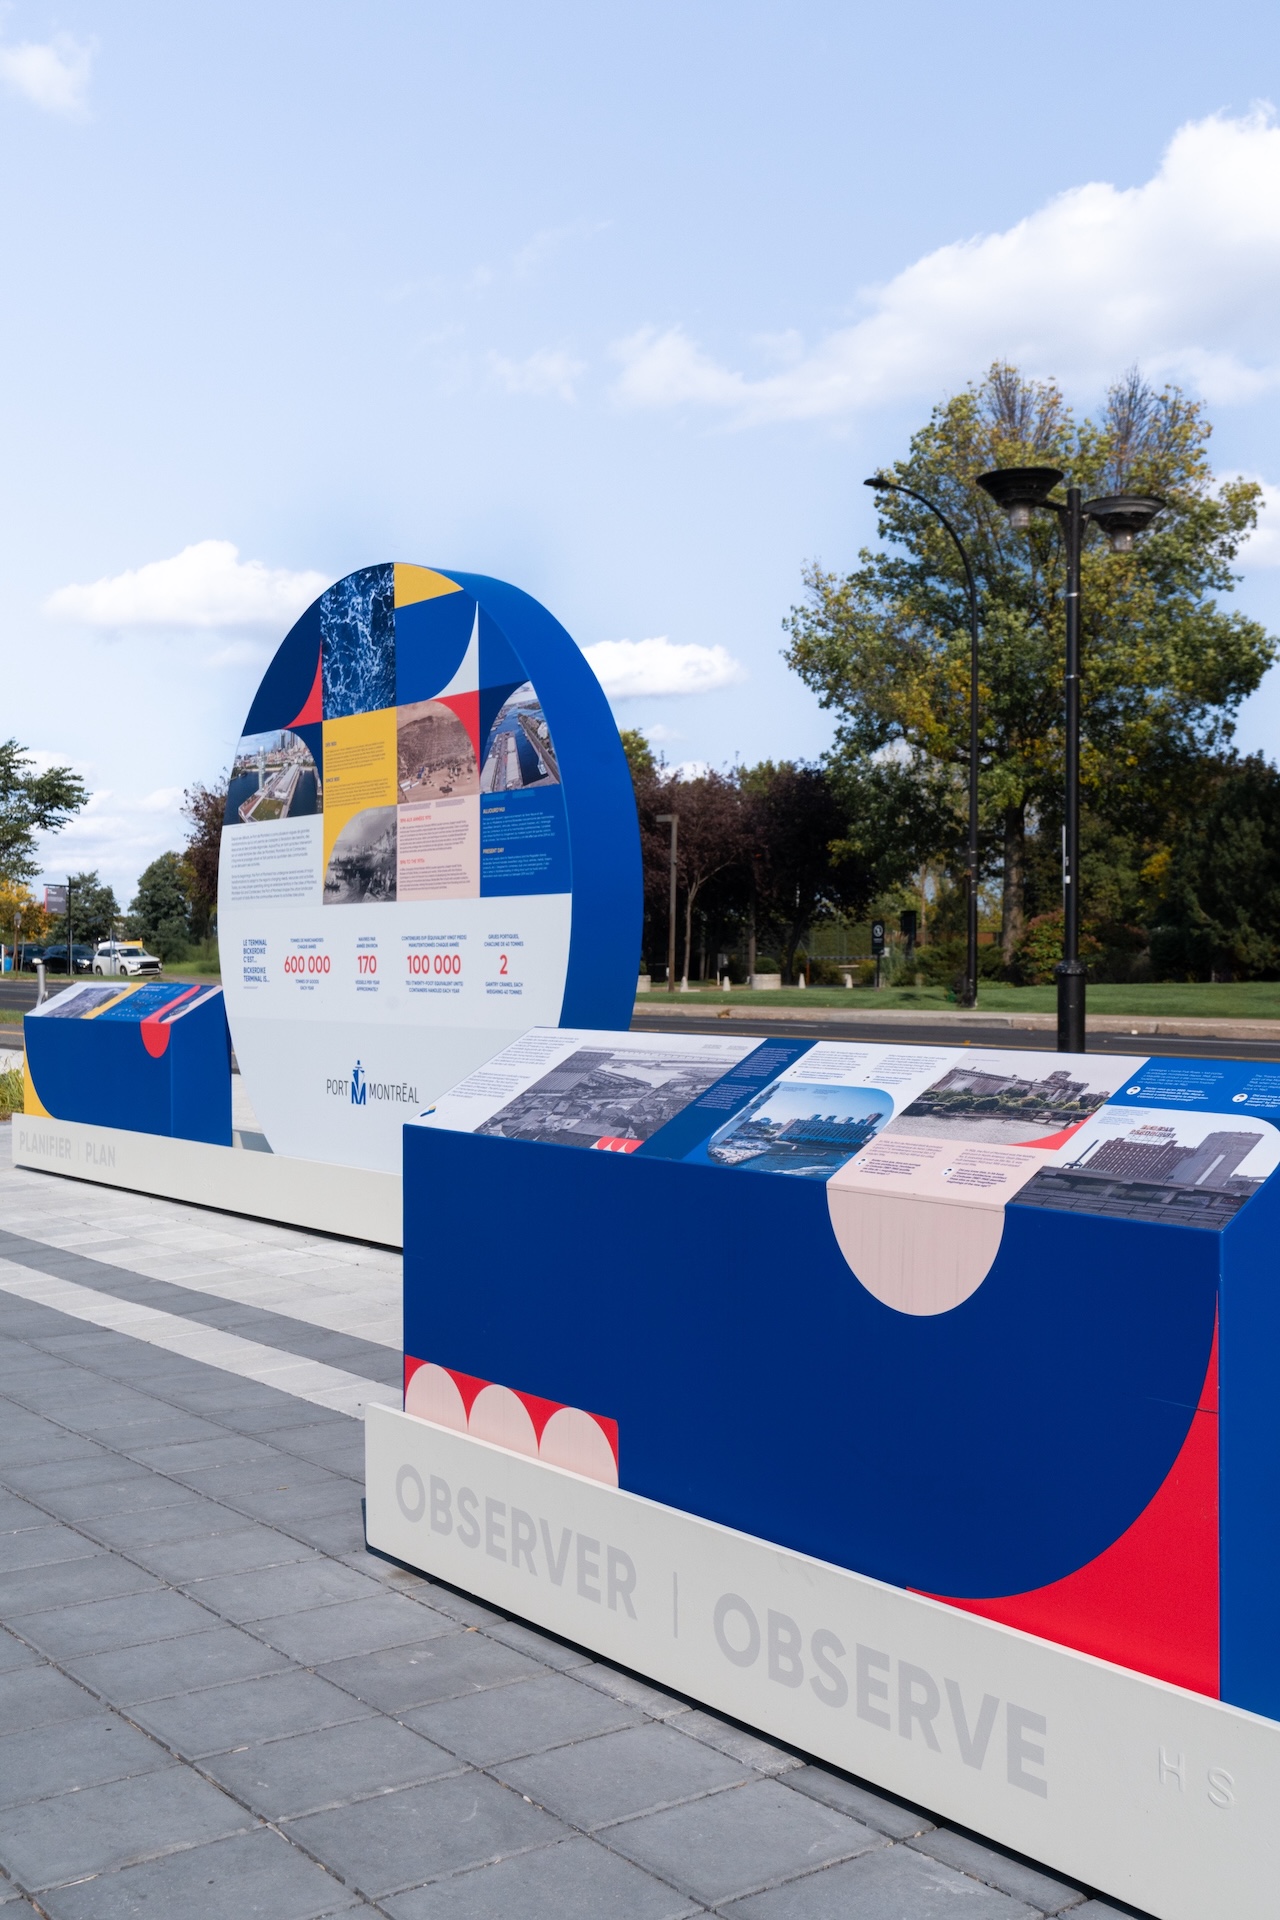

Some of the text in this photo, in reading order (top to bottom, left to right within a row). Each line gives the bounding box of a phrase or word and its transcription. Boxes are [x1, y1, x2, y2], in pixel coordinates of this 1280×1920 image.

[284, 955, 331, 974] 600 000
[357, 955, 377, 974] 170
[407, 955, 461, 975] 100 000
[499, 954, 508, 975] 2
[327, 1079, 349, 1096] PORT
[19, 1131, 116, 1168] PLANIFIER PLAN
[396, 1463, 1049, 1800] OBSERVER OBSERVE
